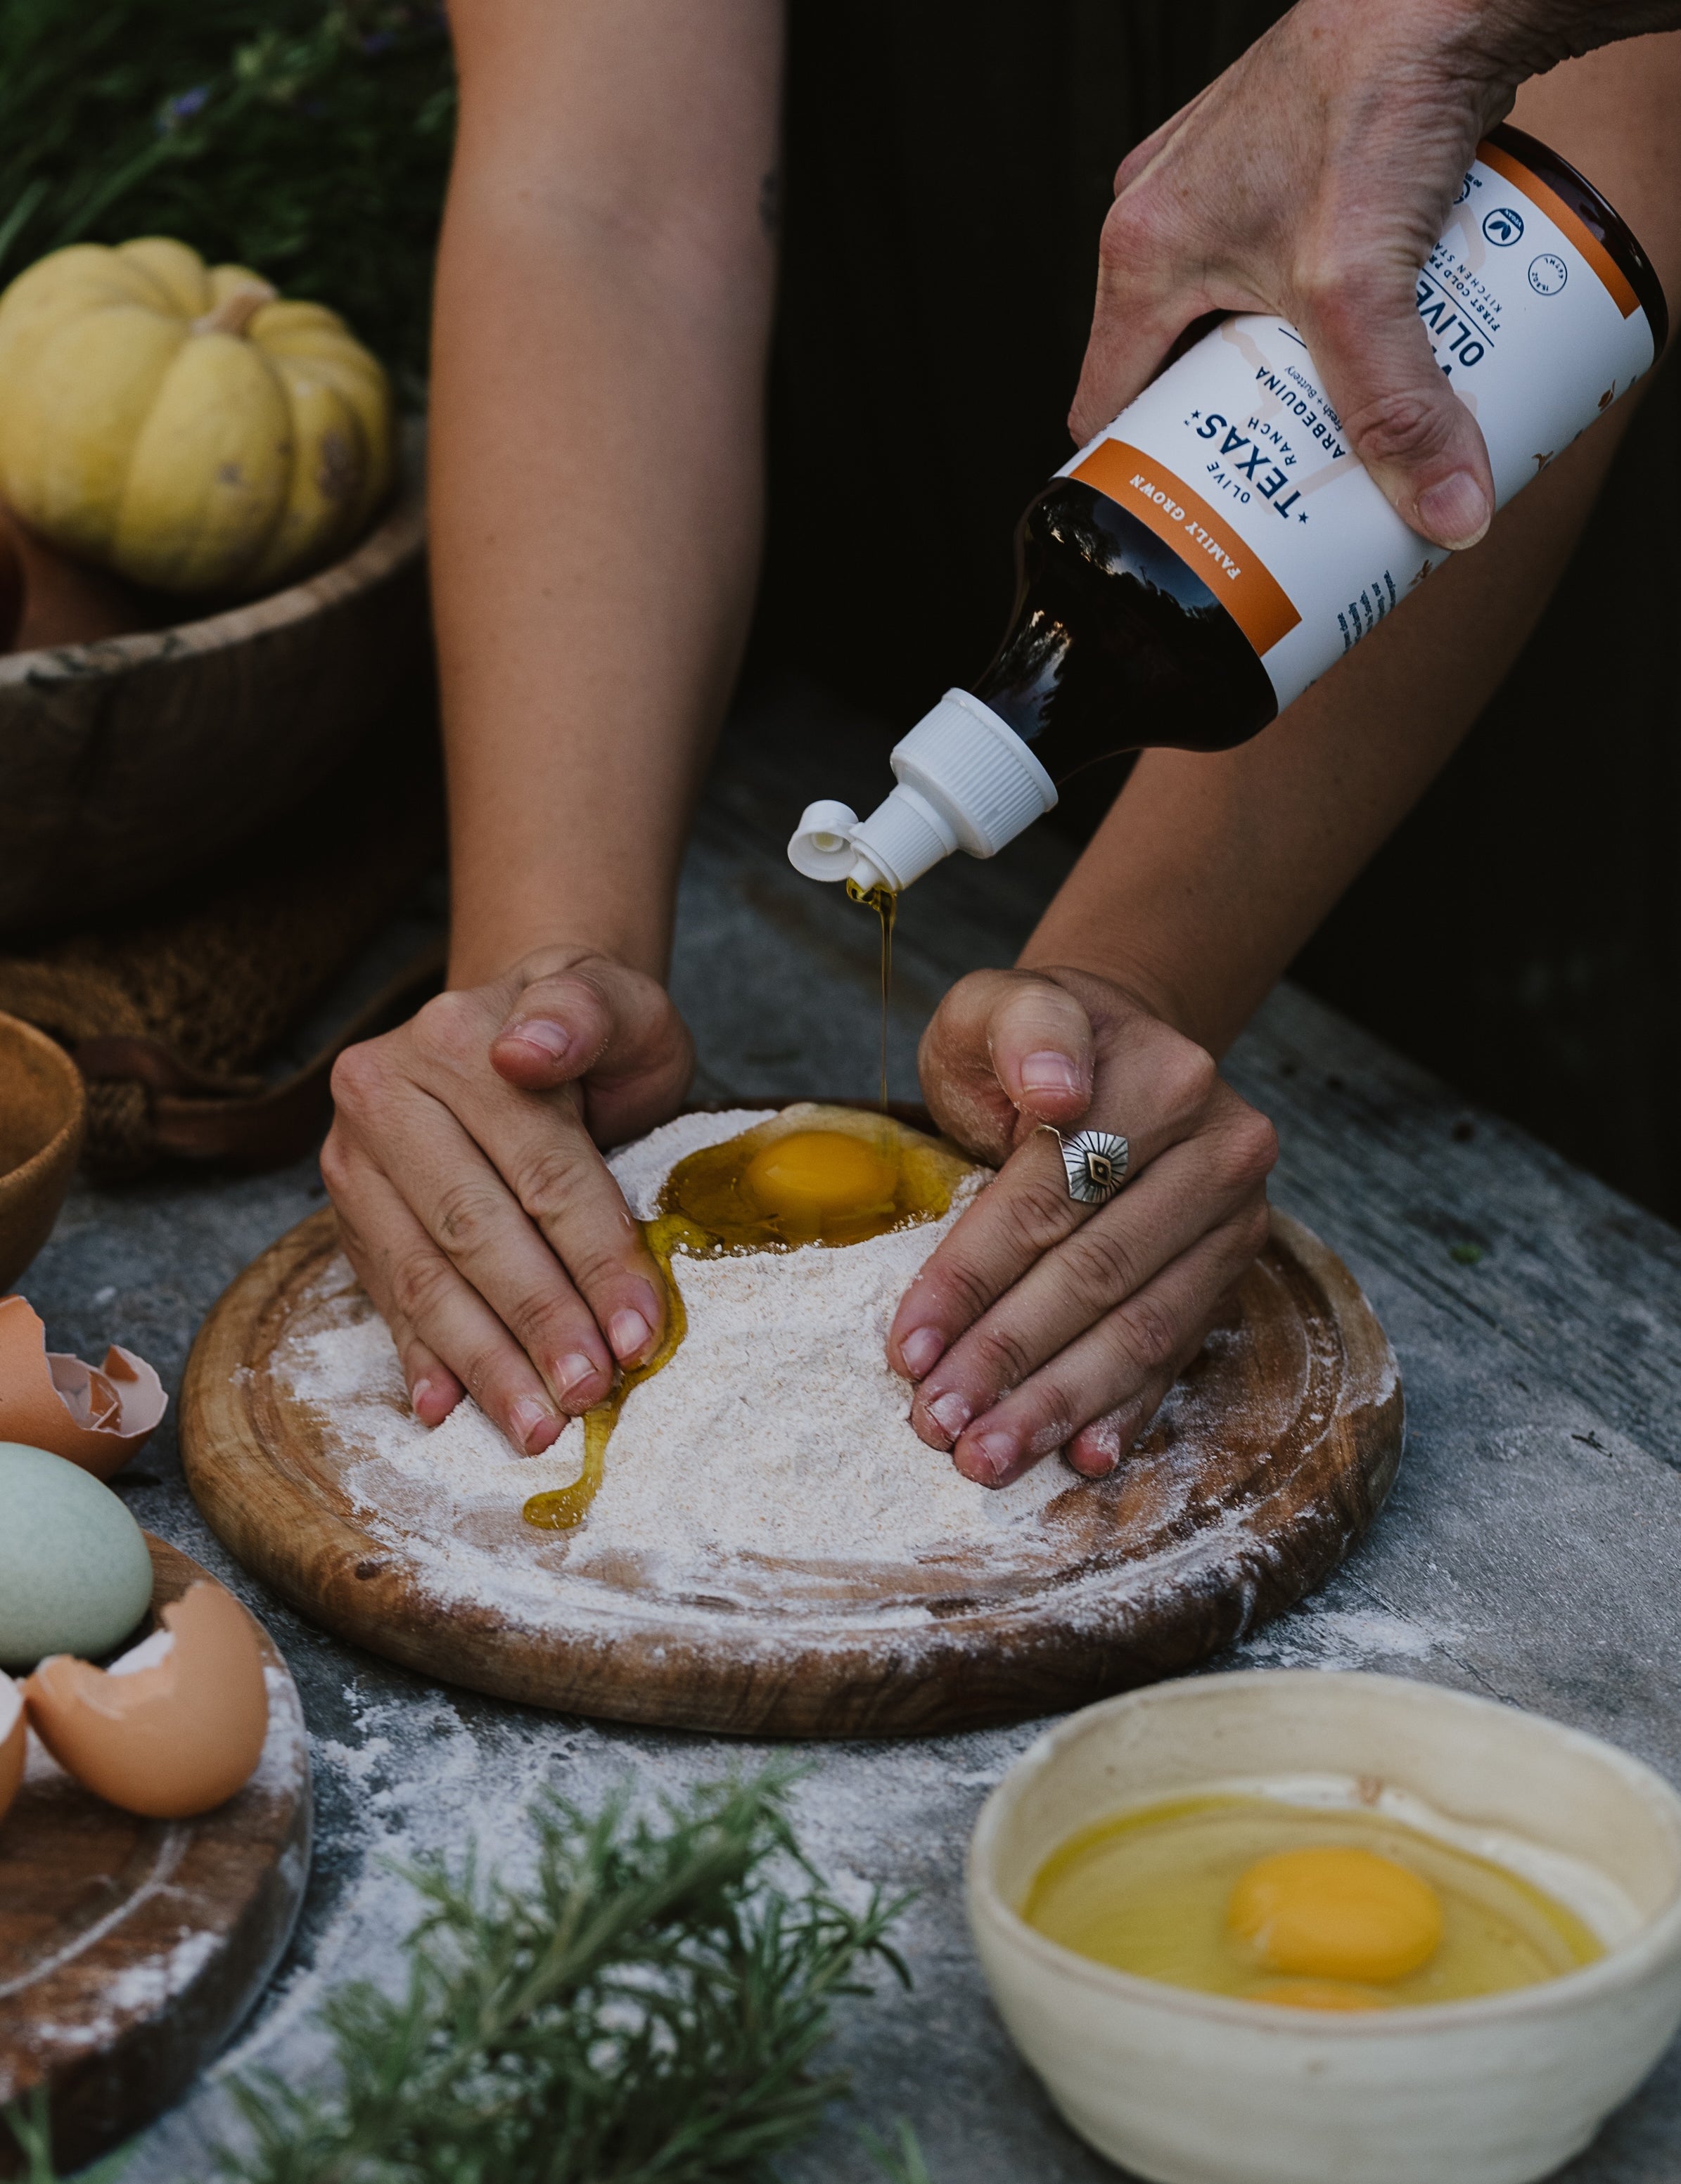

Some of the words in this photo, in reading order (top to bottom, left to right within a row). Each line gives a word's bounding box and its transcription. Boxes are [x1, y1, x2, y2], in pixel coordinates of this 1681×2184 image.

[1505, 209, 1522, 229] VEGAN
[1434, 242, 1455, 262] STA
[1443, 266, 1470, 297] COLD
[1457, 264, 1502, 313] KITCHEN
[1416, 280, 1485, 367] OLIVE
[1470, 298, 1500, 332] FIRST
[1284, 365, 1317, 399] Buttery
[1255, 366, 1346, 459] ARBEQUINA
[1323, 404, 1343, 432] Fresh
[1248, 417, 1297, 465] RANCH
[1196, 413, 1301, 519] TEXAS
[1206, 461, 1251, 503] OLIVE
[1129, 474, 1186, 521] GROWN
[1184, 521, 1241, 580] FAMILY
[1360, 590, 1372, 617] South.
